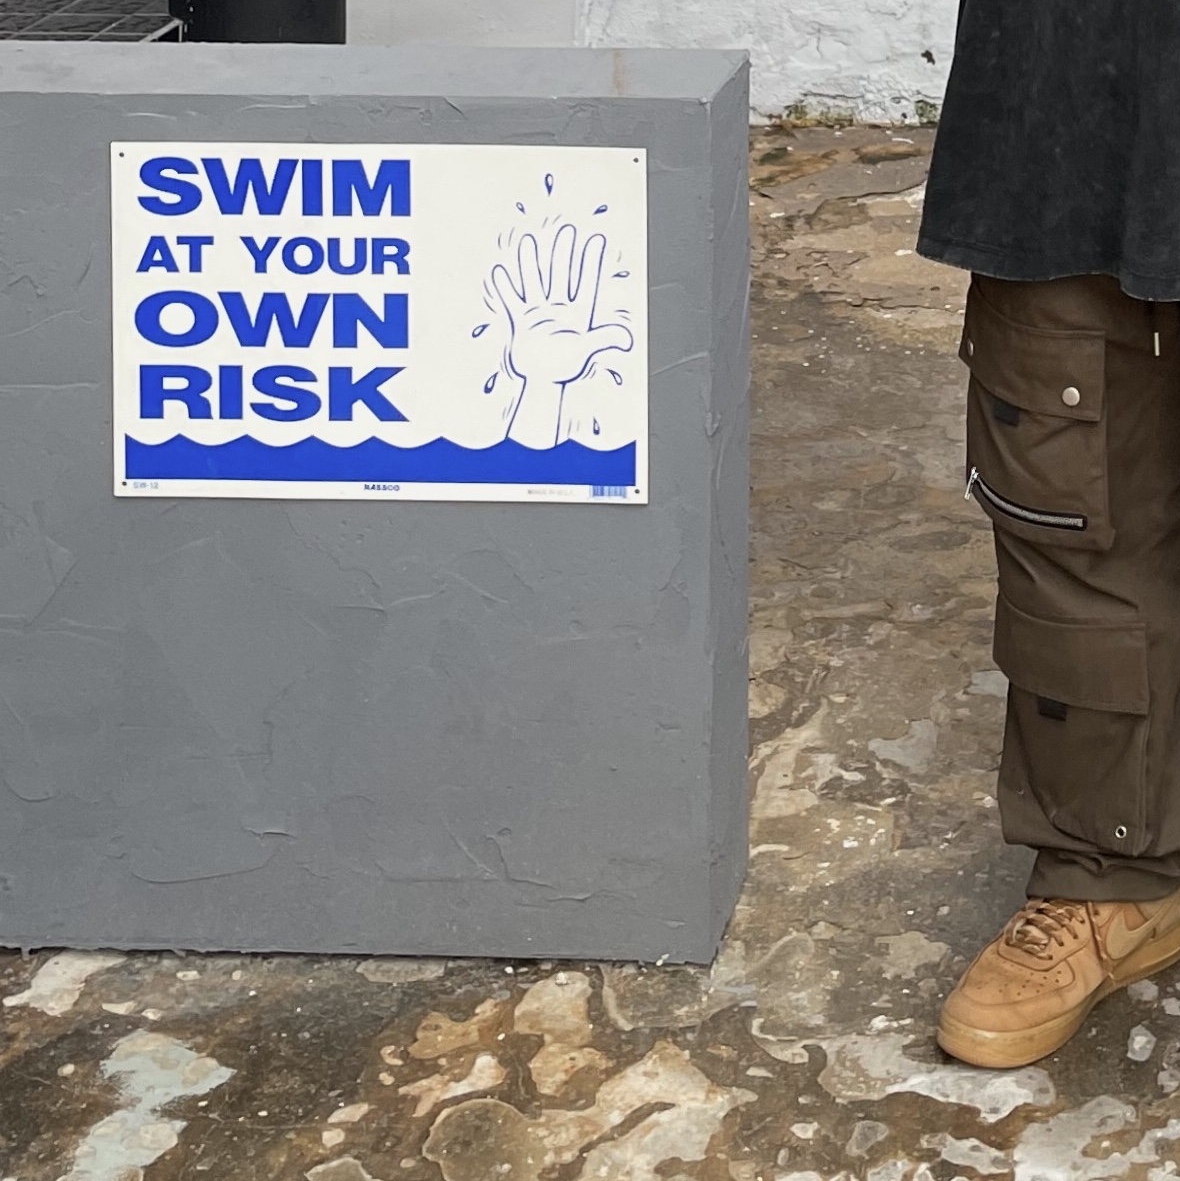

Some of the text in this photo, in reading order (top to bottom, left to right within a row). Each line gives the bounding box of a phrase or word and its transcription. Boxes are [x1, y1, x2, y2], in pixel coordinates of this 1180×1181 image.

[137, 157, 411, 216] SWIM
[136, 236, 409, 274] AT YOUR
[134, 290, 408, 348] OWN
[140, 364, 409, 422] RISK
